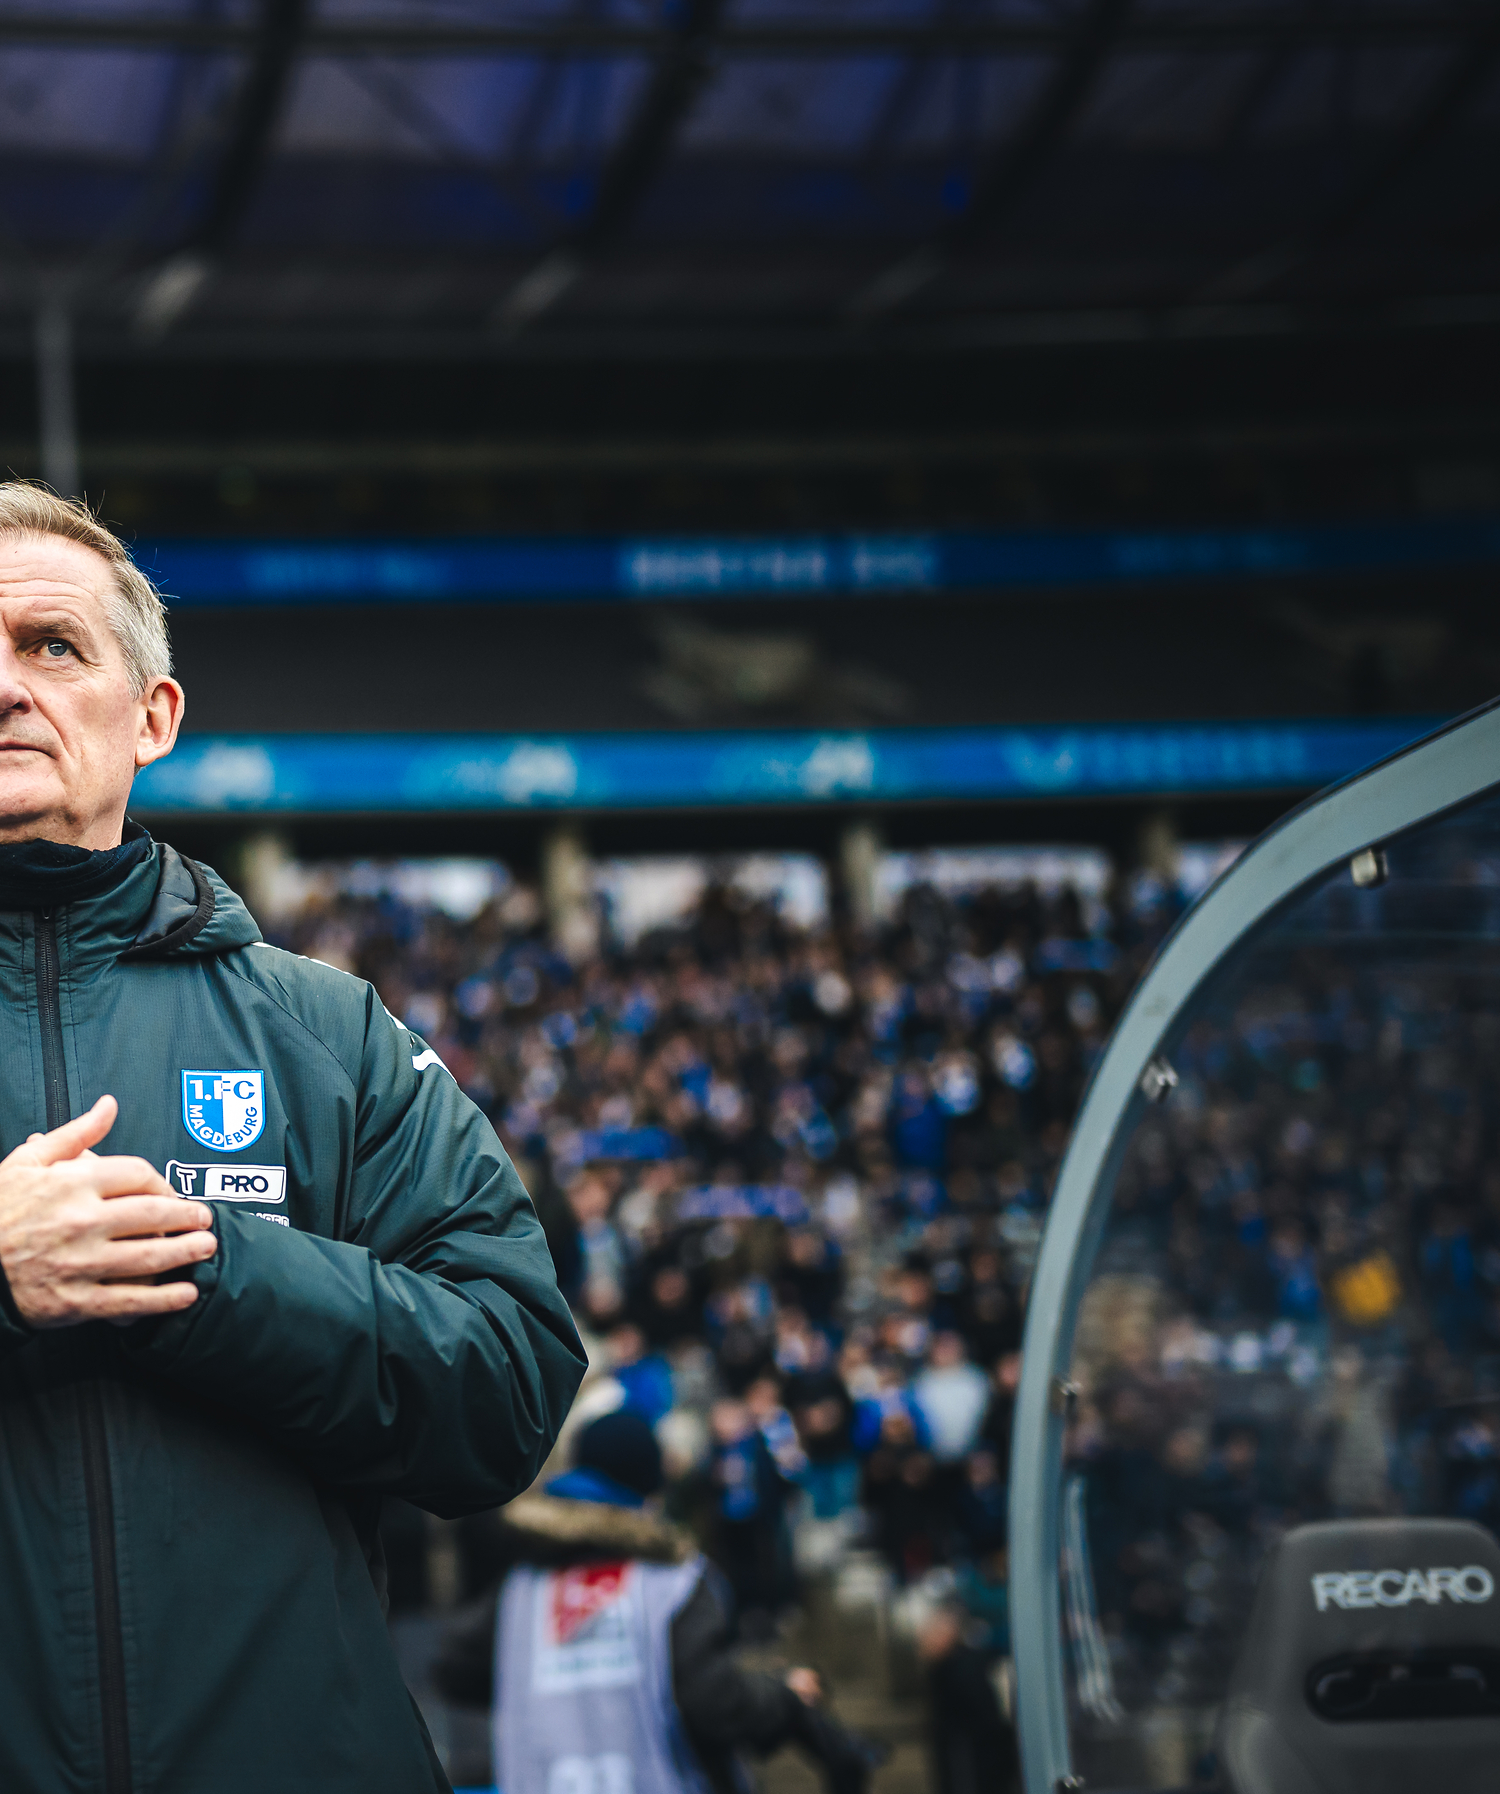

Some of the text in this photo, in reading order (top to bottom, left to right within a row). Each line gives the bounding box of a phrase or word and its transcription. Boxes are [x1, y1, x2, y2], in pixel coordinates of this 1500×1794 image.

[189, 1104, 258, 1146] MAGDEBURG
[220, 1174, 269, 1193] PRO
[1311, 1565, 1495, 1613] RECARO
